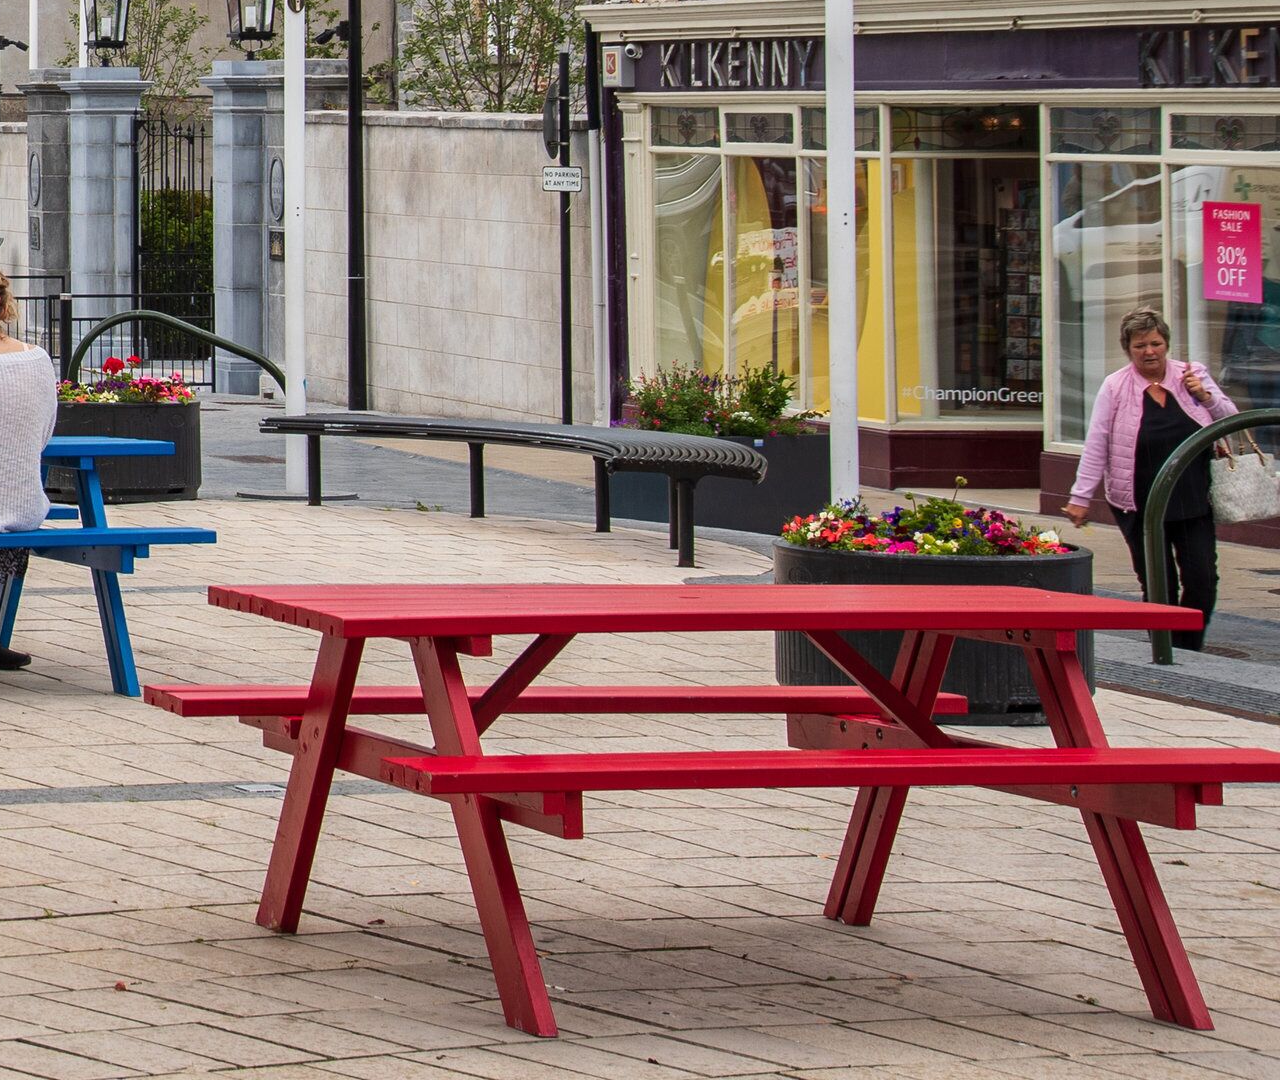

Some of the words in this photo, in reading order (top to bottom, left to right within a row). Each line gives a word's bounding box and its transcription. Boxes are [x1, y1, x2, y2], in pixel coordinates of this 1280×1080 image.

[660, 40, 813, 87] KILKENNY
[1213, 209, 1250, 220] FASHION
[1221, 222, 1242, 232] SALE
[1217, 246, 1247, 266] 30%
[1218, 268, 1247, 287] OFF
